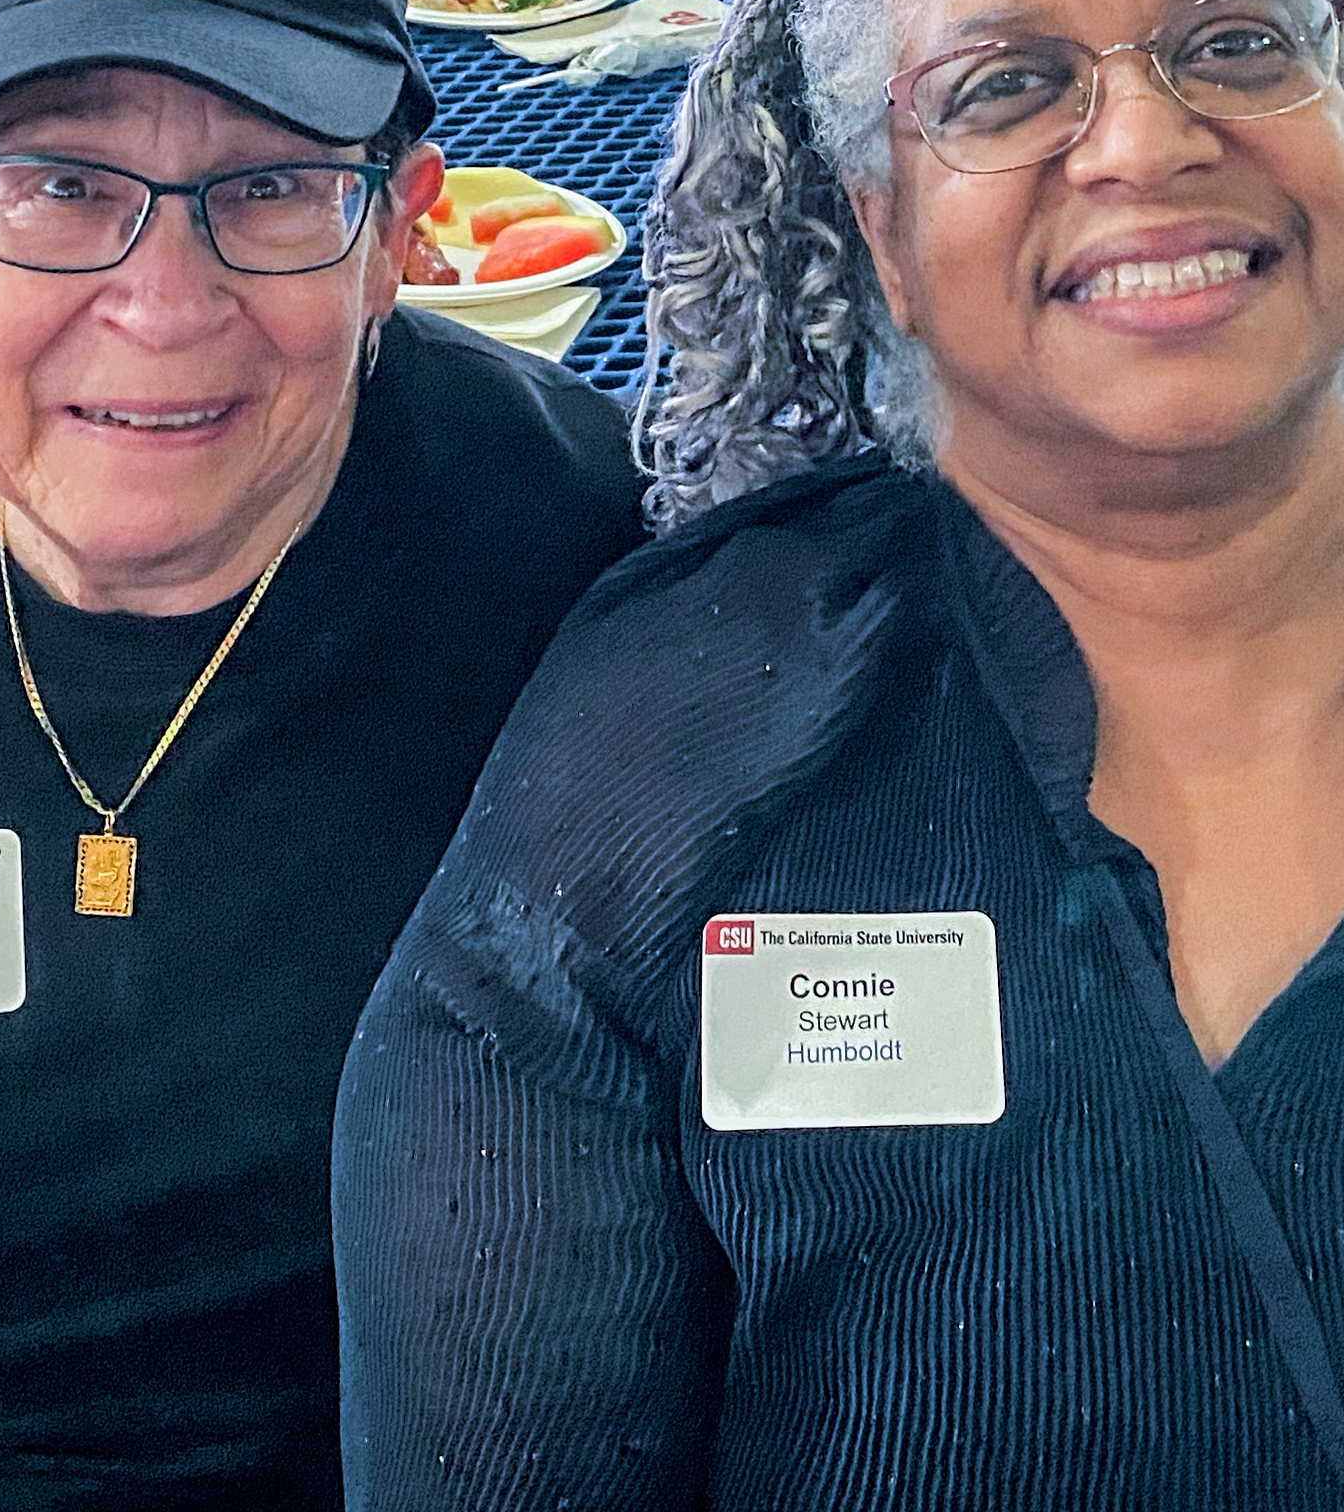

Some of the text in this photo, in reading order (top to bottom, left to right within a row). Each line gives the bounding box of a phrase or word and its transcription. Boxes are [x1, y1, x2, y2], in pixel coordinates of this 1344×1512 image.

[719, 926, 965, 949] CSU The California State University
[789, 972, 896, 999] Connie
[798, 1008, 890, 1032] Stewart
[786, 1039, 904, 1065] Humboldt
